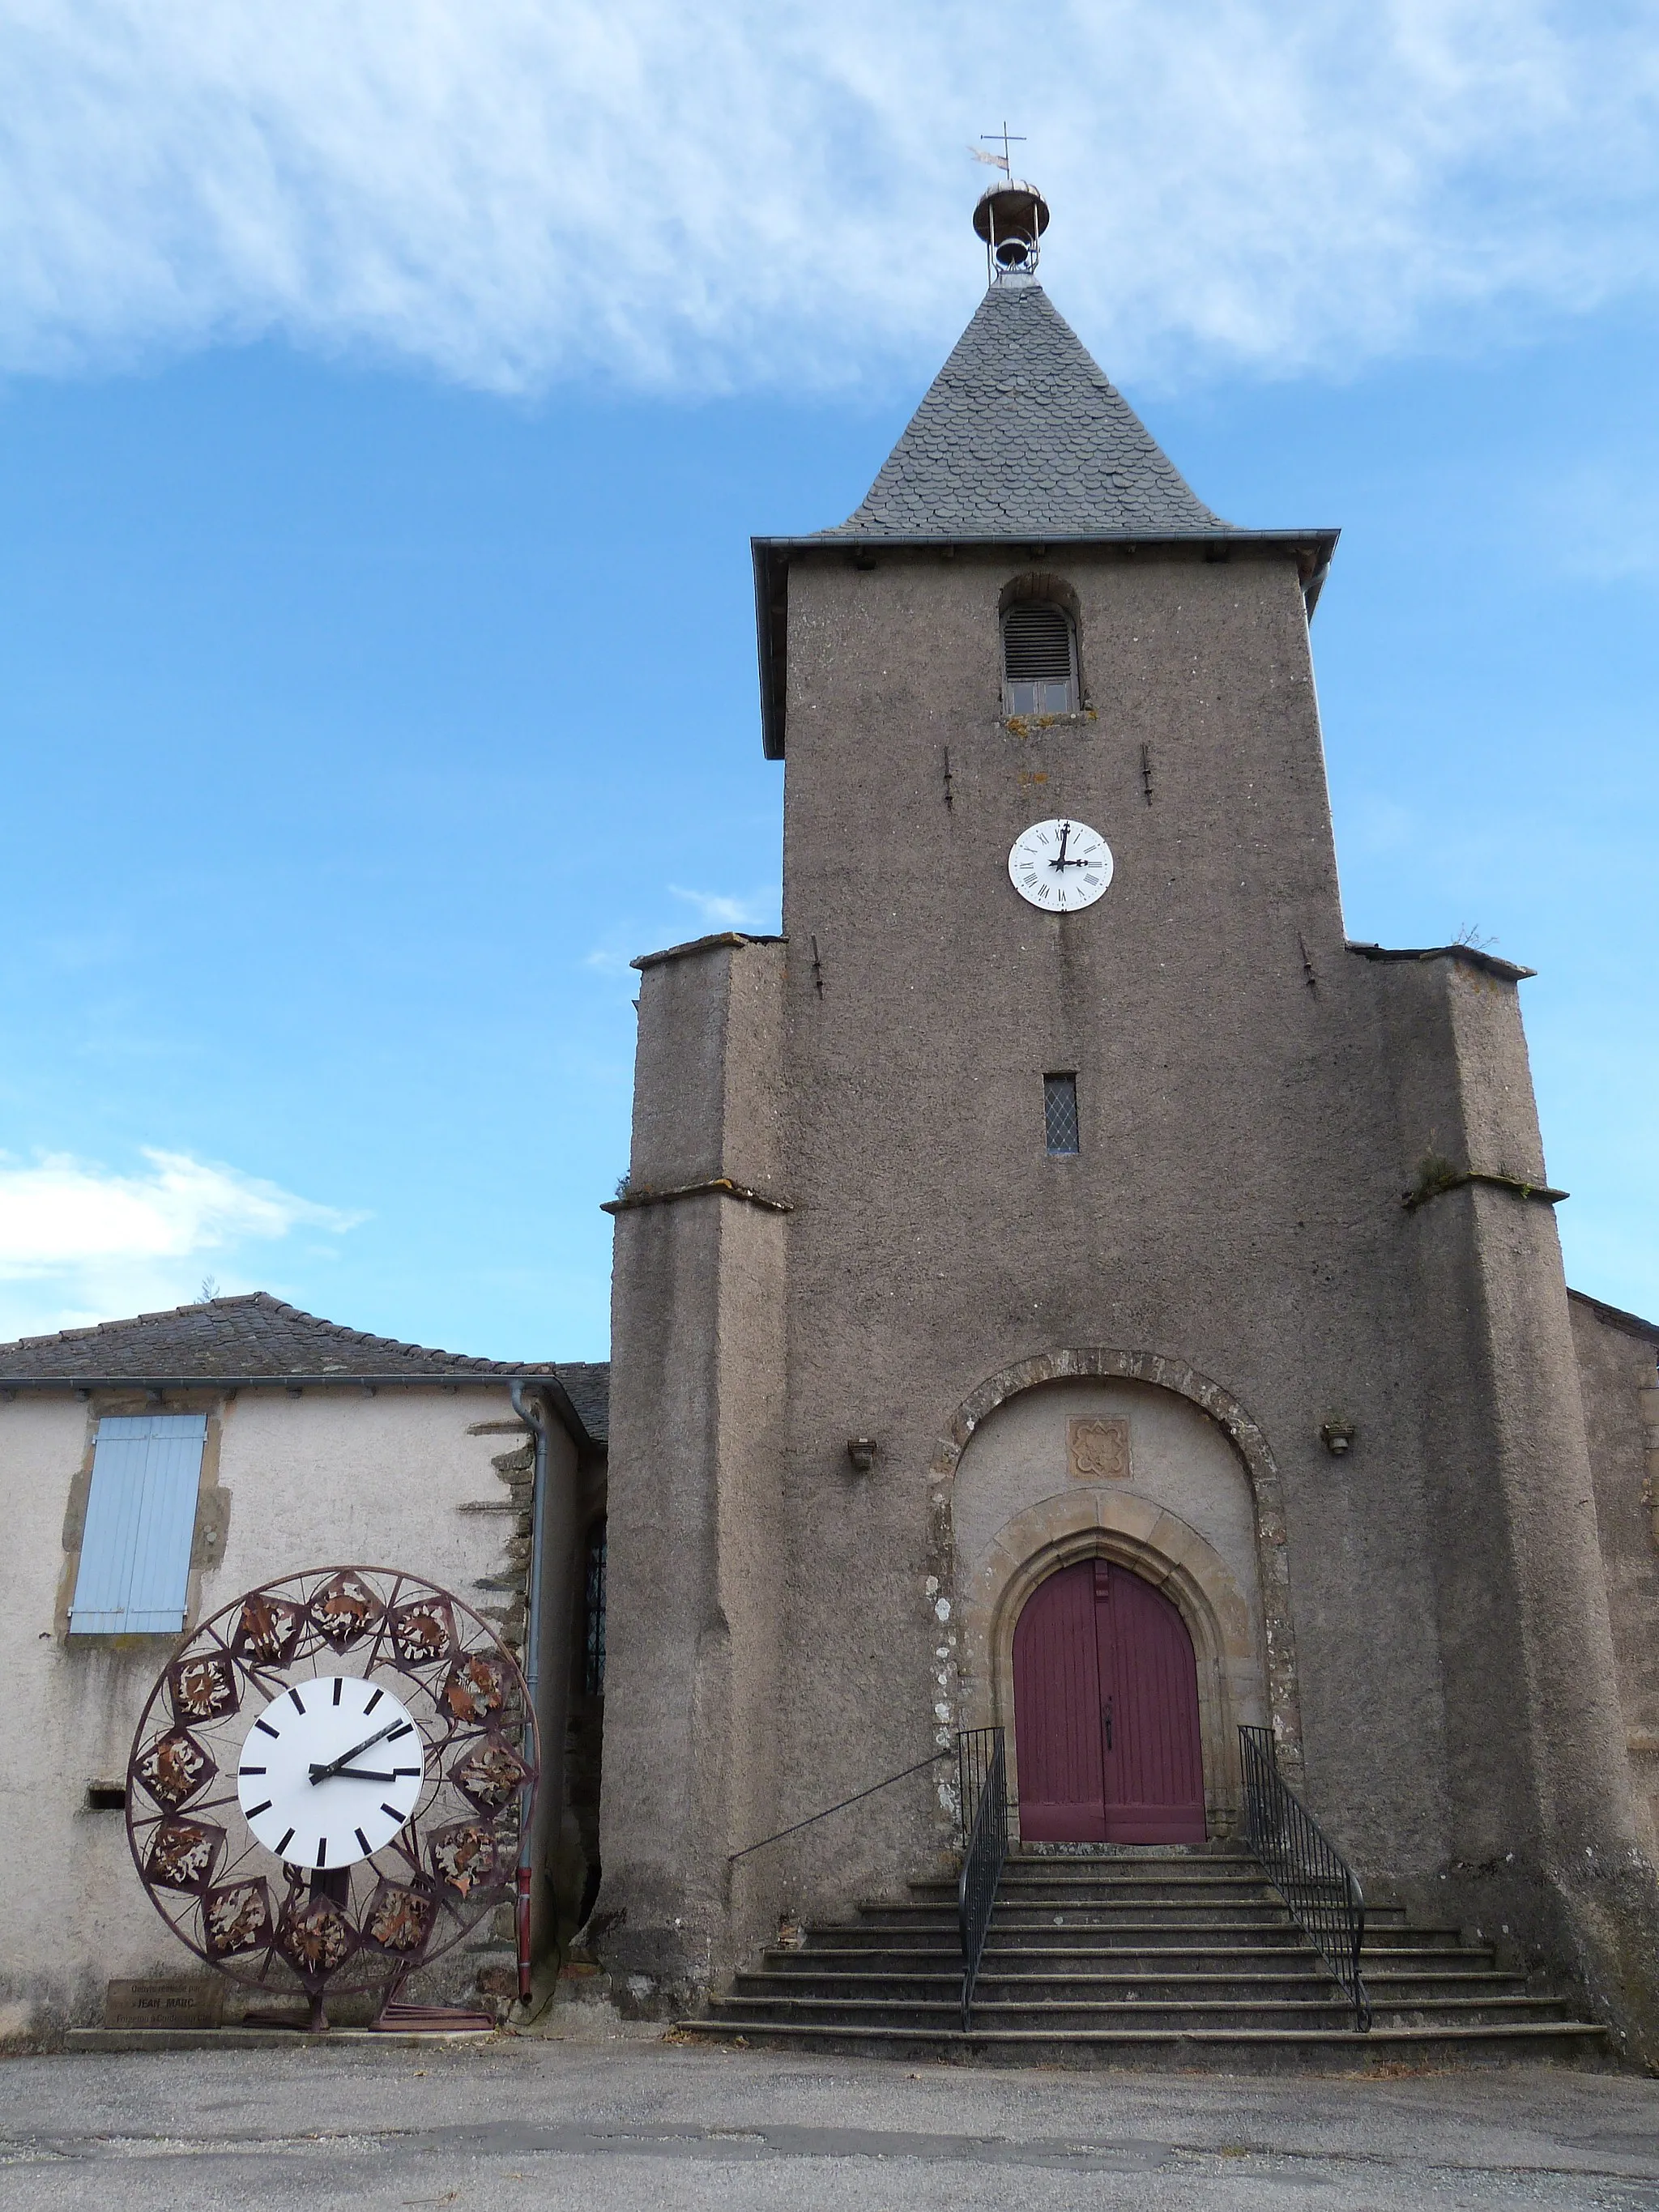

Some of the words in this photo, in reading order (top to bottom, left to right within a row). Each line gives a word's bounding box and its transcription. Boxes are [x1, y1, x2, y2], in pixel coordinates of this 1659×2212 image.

[1037, 833, 1049, 846] XI
[1055, 829, 1064, 842] XI
[1073, 833, 1081, 845] I
[1024, 847, 1038, 855] X
[1083, 845, 1097, 855] II
[1023, 872, 1038, 888] VIII
[1038, 884, 1050, 899] VII
[1058, 889, 1066, 901] VI
[1077, 886, 1085, 897] V
[139, 1998, 160, 2008] JEAN
[166, 1998, 194, 2008] MARC
